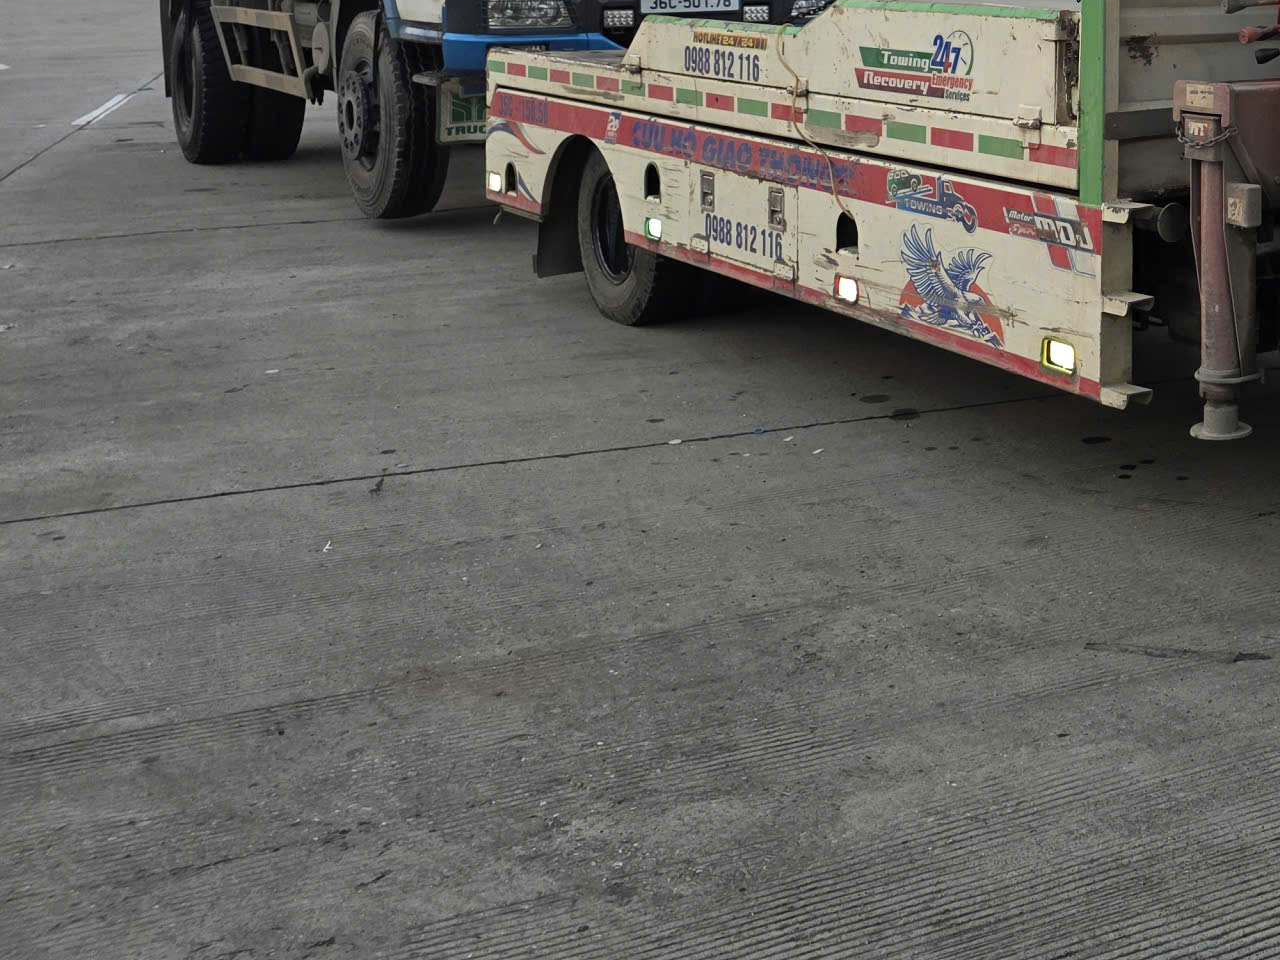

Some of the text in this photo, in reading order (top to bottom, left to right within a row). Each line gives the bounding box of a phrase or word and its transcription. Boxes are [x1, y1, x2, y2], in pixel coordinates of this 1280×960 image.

[693, 31, 721, 46] HOTLINE
[685, 45, 760, 82] 0988 812 116
[881, 50, 929, 73] Towing
[863, 71, 930, 95] Recovery
[932, 73, 974, 91] Emergency
[945, 89, 971, 102] Services
[702, 135, 753, 172] GIAO
[904, 198, 943, 215] TOWING
[1008, 210, 1033, 222] Motor
[705, 212, 783, 261] 0988 812 116
